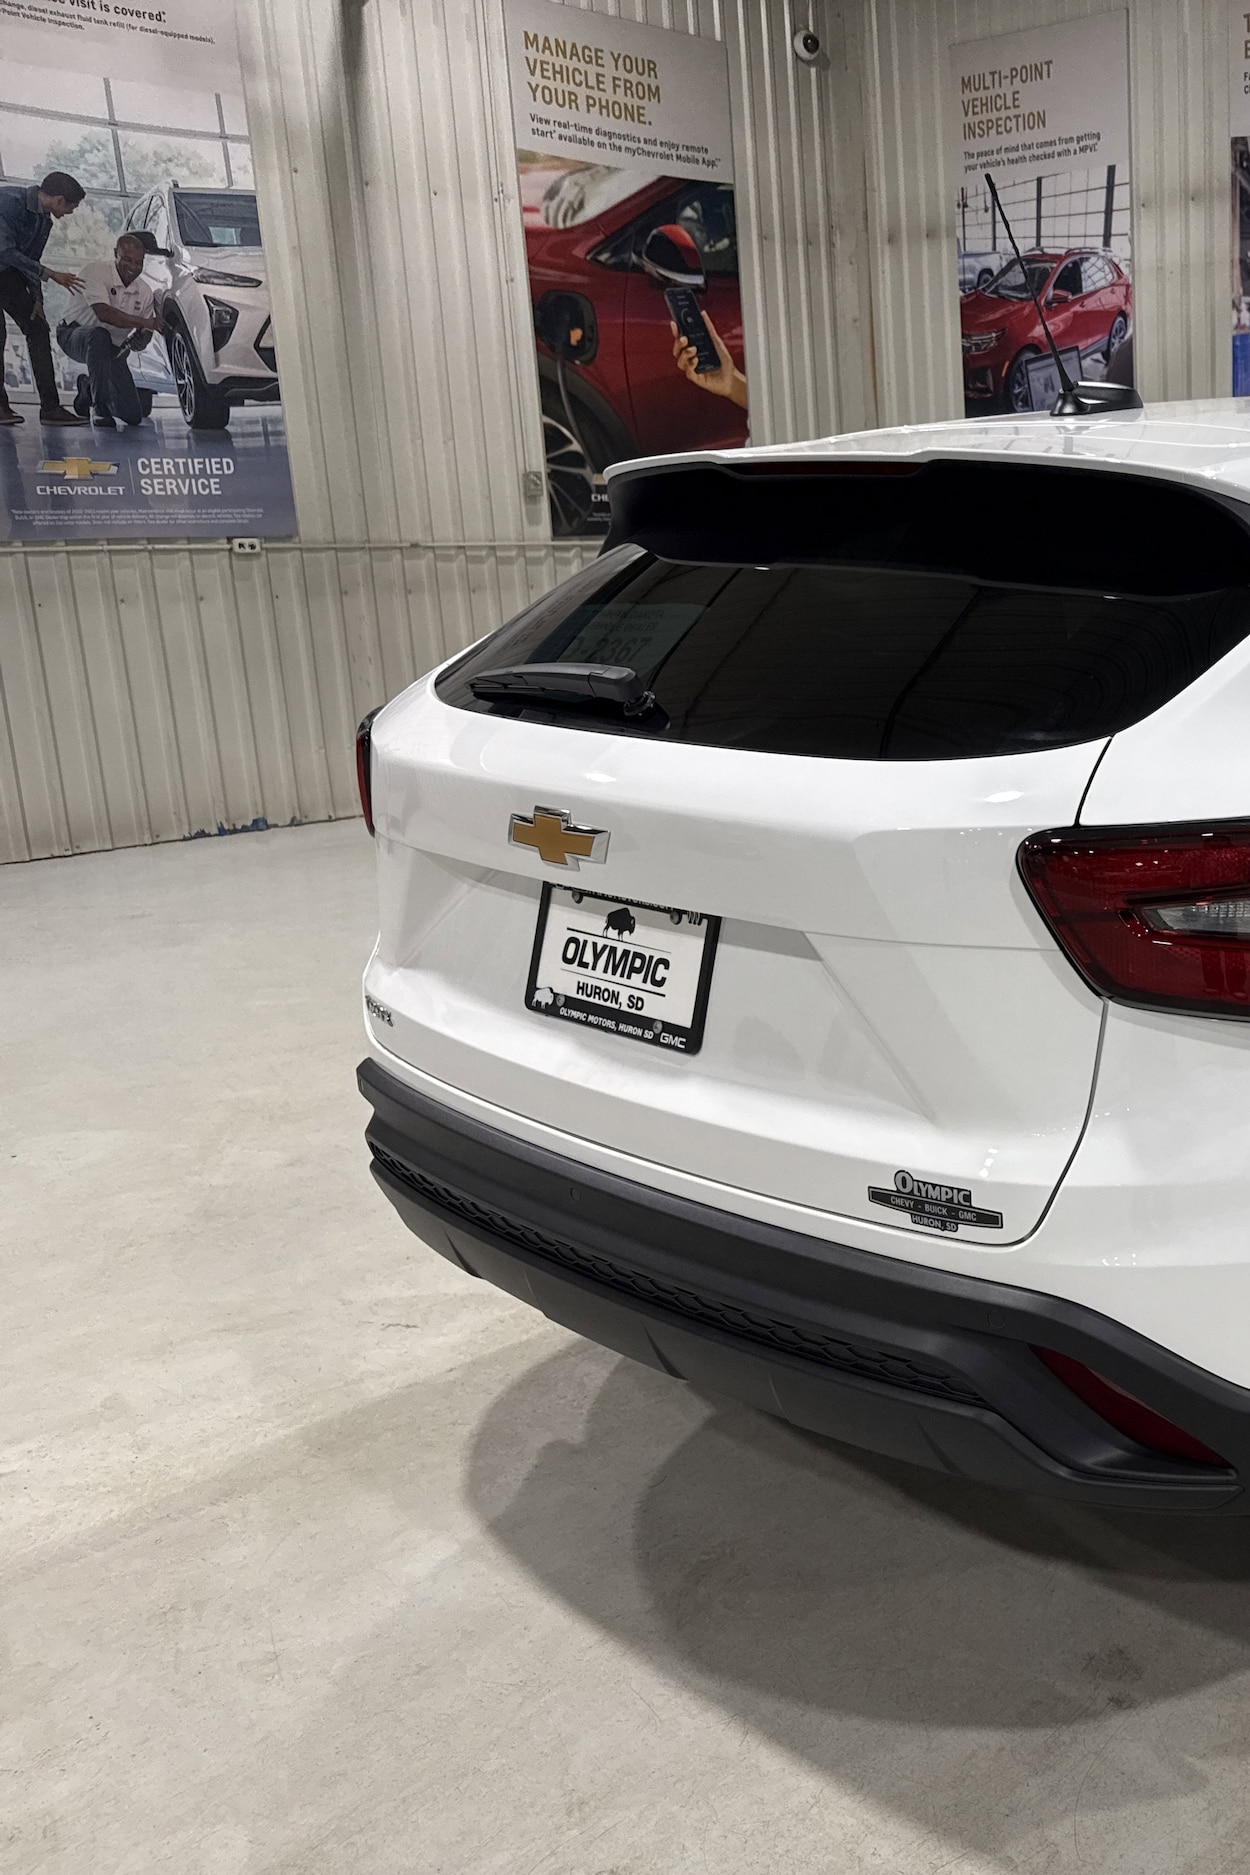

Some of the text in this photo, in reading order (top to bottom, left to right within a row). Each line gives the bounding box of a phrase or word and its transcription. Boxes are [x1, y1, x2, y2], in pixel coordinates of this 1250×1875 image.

[21, 12, 46, 22] Vehicle
[100, 1, 110, 13] is
[523, 30, 658, 80] MANAGE YOUR
[524, 56, 661, 104] VEHICLE FROM
[961, 60, 1053, 94] MULTI-POINT
[527, 82, 652, 126] YOUR PHONE.
[962, 91, 1020, 118] VEHICLE
[530, 112, 709, 155] View real-time diagnostics and enjoy remote
[963, 110, 1046, 141] INSPECTION
[558, 134, 595, 148] available
[597, 142, 608, 150] on
[608, 142, 622, 154] the
[624, 146, 674, 163] myChevrolet
[676, 153, 700, 166] Mobile
[964, 132, 1101, 160] The peace of mind that comes from getting
[964, 162, 978, 174] your
[1006, 154, 1028, 166] health
[1028, 150, 1056, 162] checked
[1056, 147, 1072, 158] with
[137, 458, 235, 475] CERTIFIED
[36, 486, 125, 496] CHEVROLET
[140, 478, 222, 496] SERVICE
[562, 936, 670, 988] OLYMPIC
[576, 981, 644, 1012] HURON, SD
[560, 1007, 654, 1040] OLYMPIC MOTORS, HURON SD
[660, 1032, 687, 1048] GMC
[890, 1196, 914, 1209] CHEVY
[924, 1203, 948, 1216] BUICK
[958, 1210, 977, 1222] GMC
[912, 1215, 957, 1232] HURON, SD
